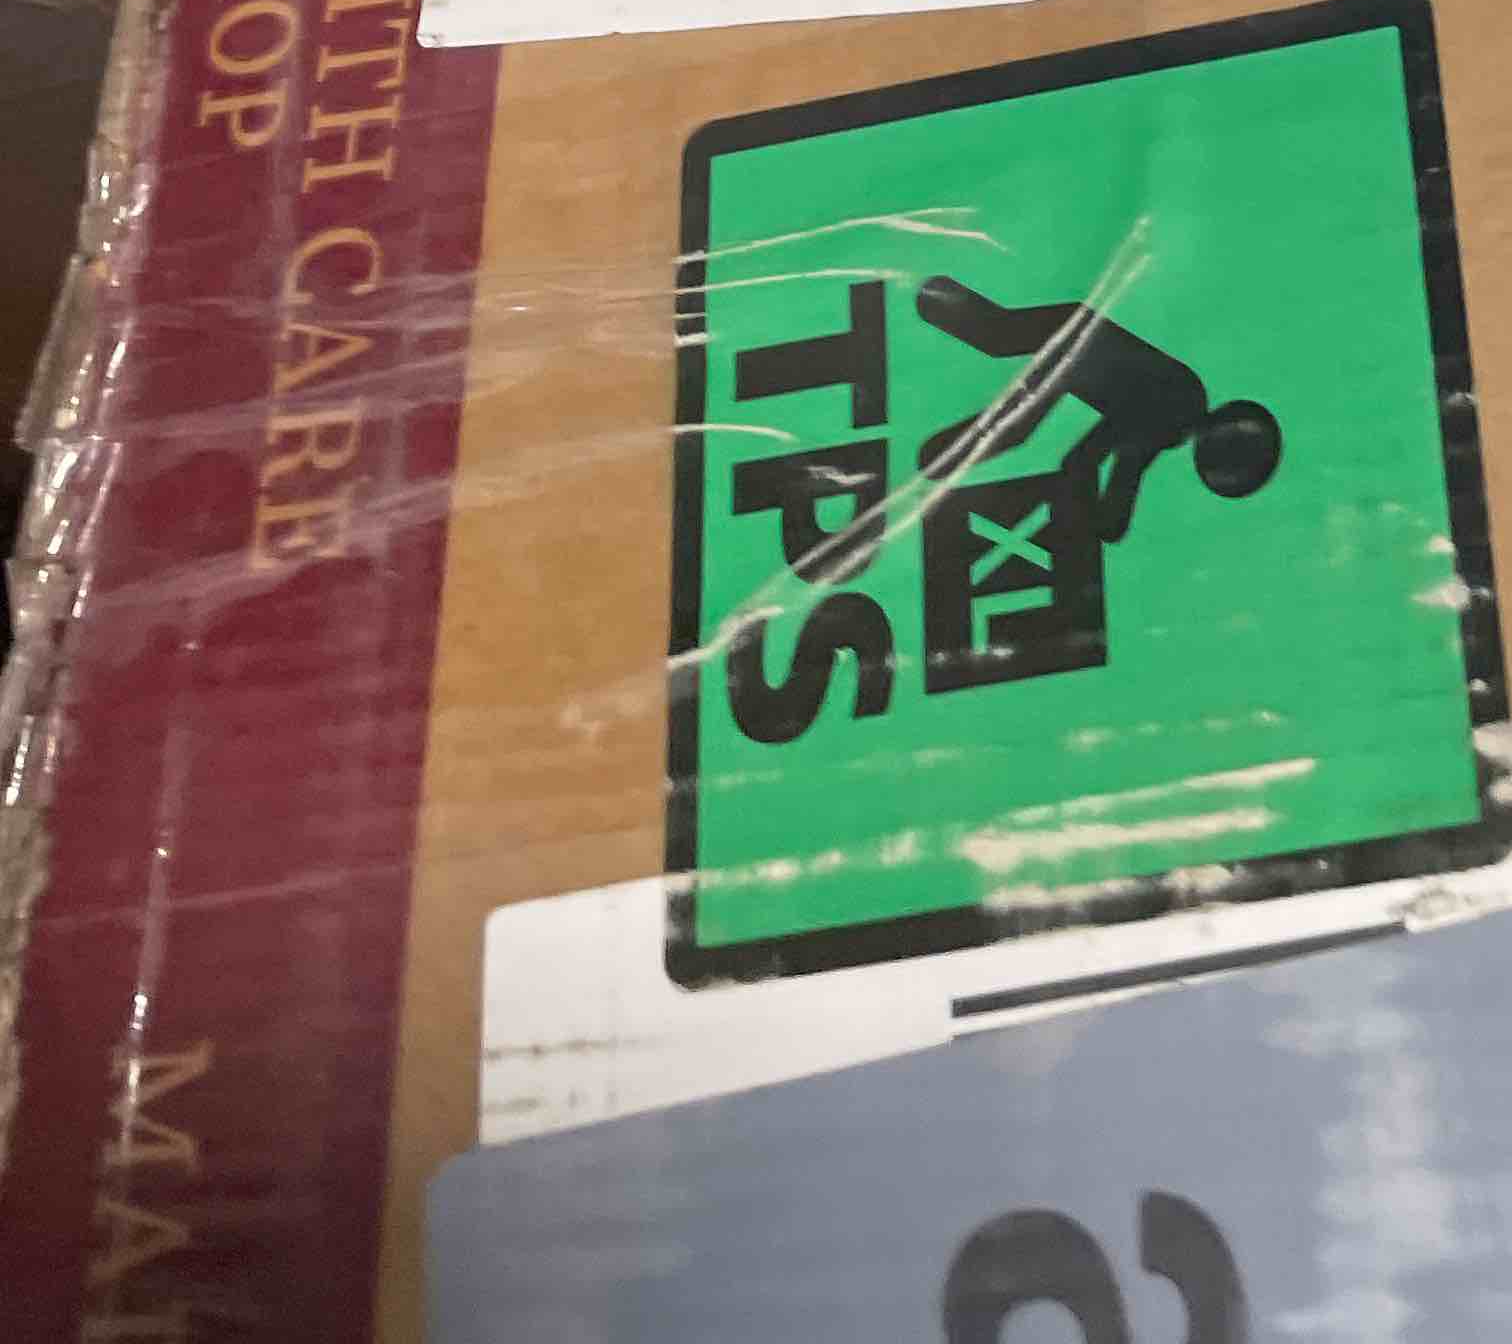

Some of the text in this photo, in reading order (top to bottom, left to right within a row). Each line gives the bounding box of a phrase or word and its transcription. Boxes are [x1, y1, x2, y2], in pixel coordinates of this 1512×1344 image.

[249, 228, 381, 572] CARE
[727, 281, 892, 743] TPS
[966, 504, 1052, 654] XL
